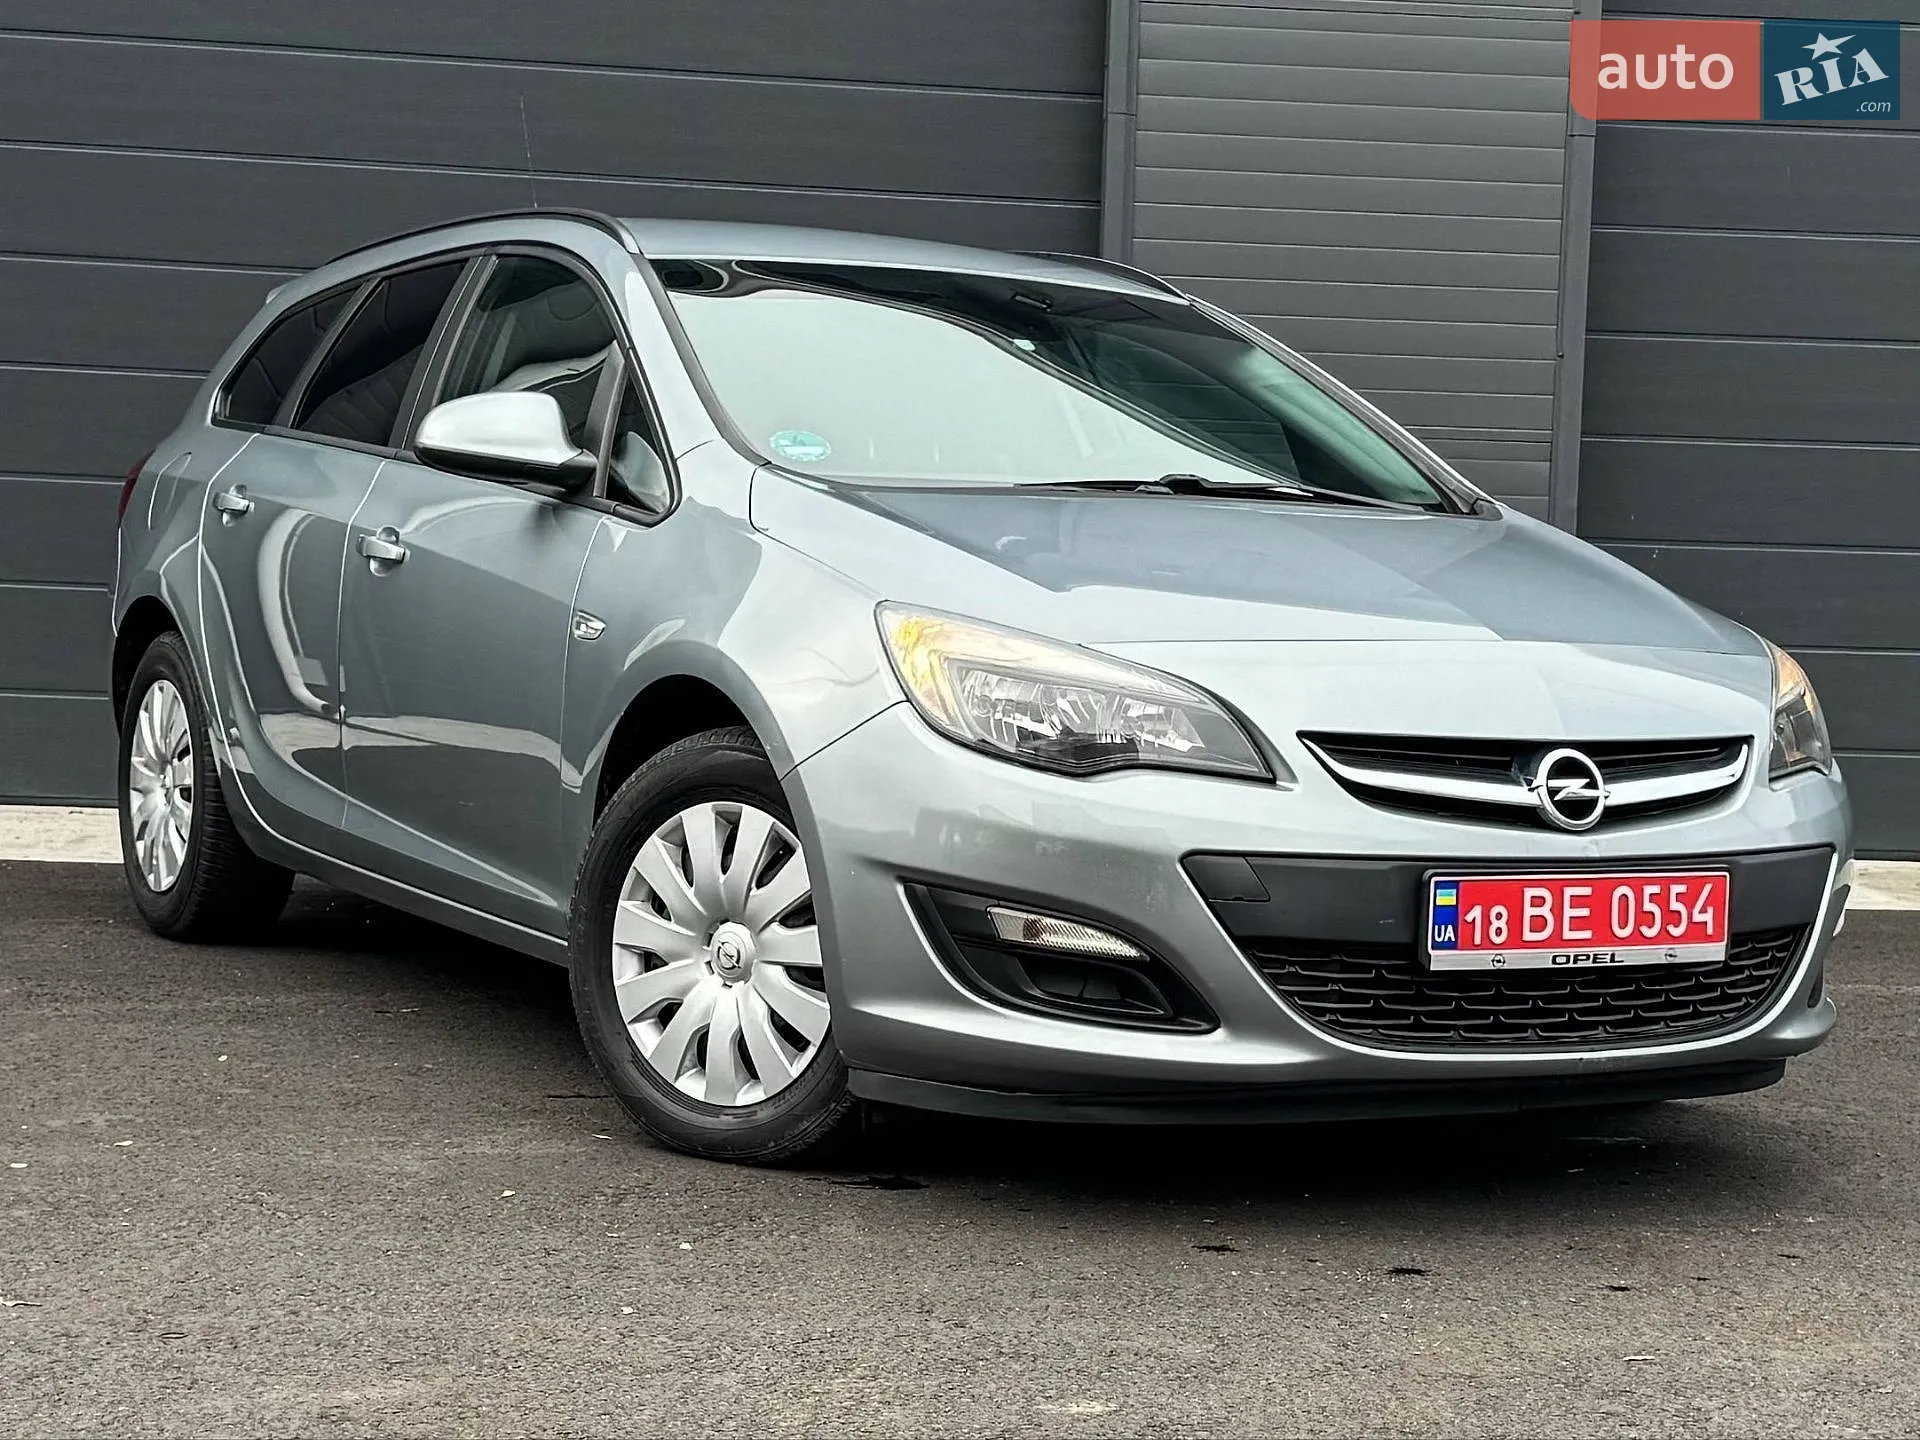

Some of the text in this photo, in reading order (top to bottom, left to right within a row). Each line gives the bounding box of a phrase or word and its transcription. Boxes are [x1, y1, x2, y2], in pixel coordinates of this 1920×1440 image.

[1464, 883, 1714, 945] 18 BE 0554
[1433, 924, 1455, 942] UA
[1551, 952, 1624, 965] OPEL
